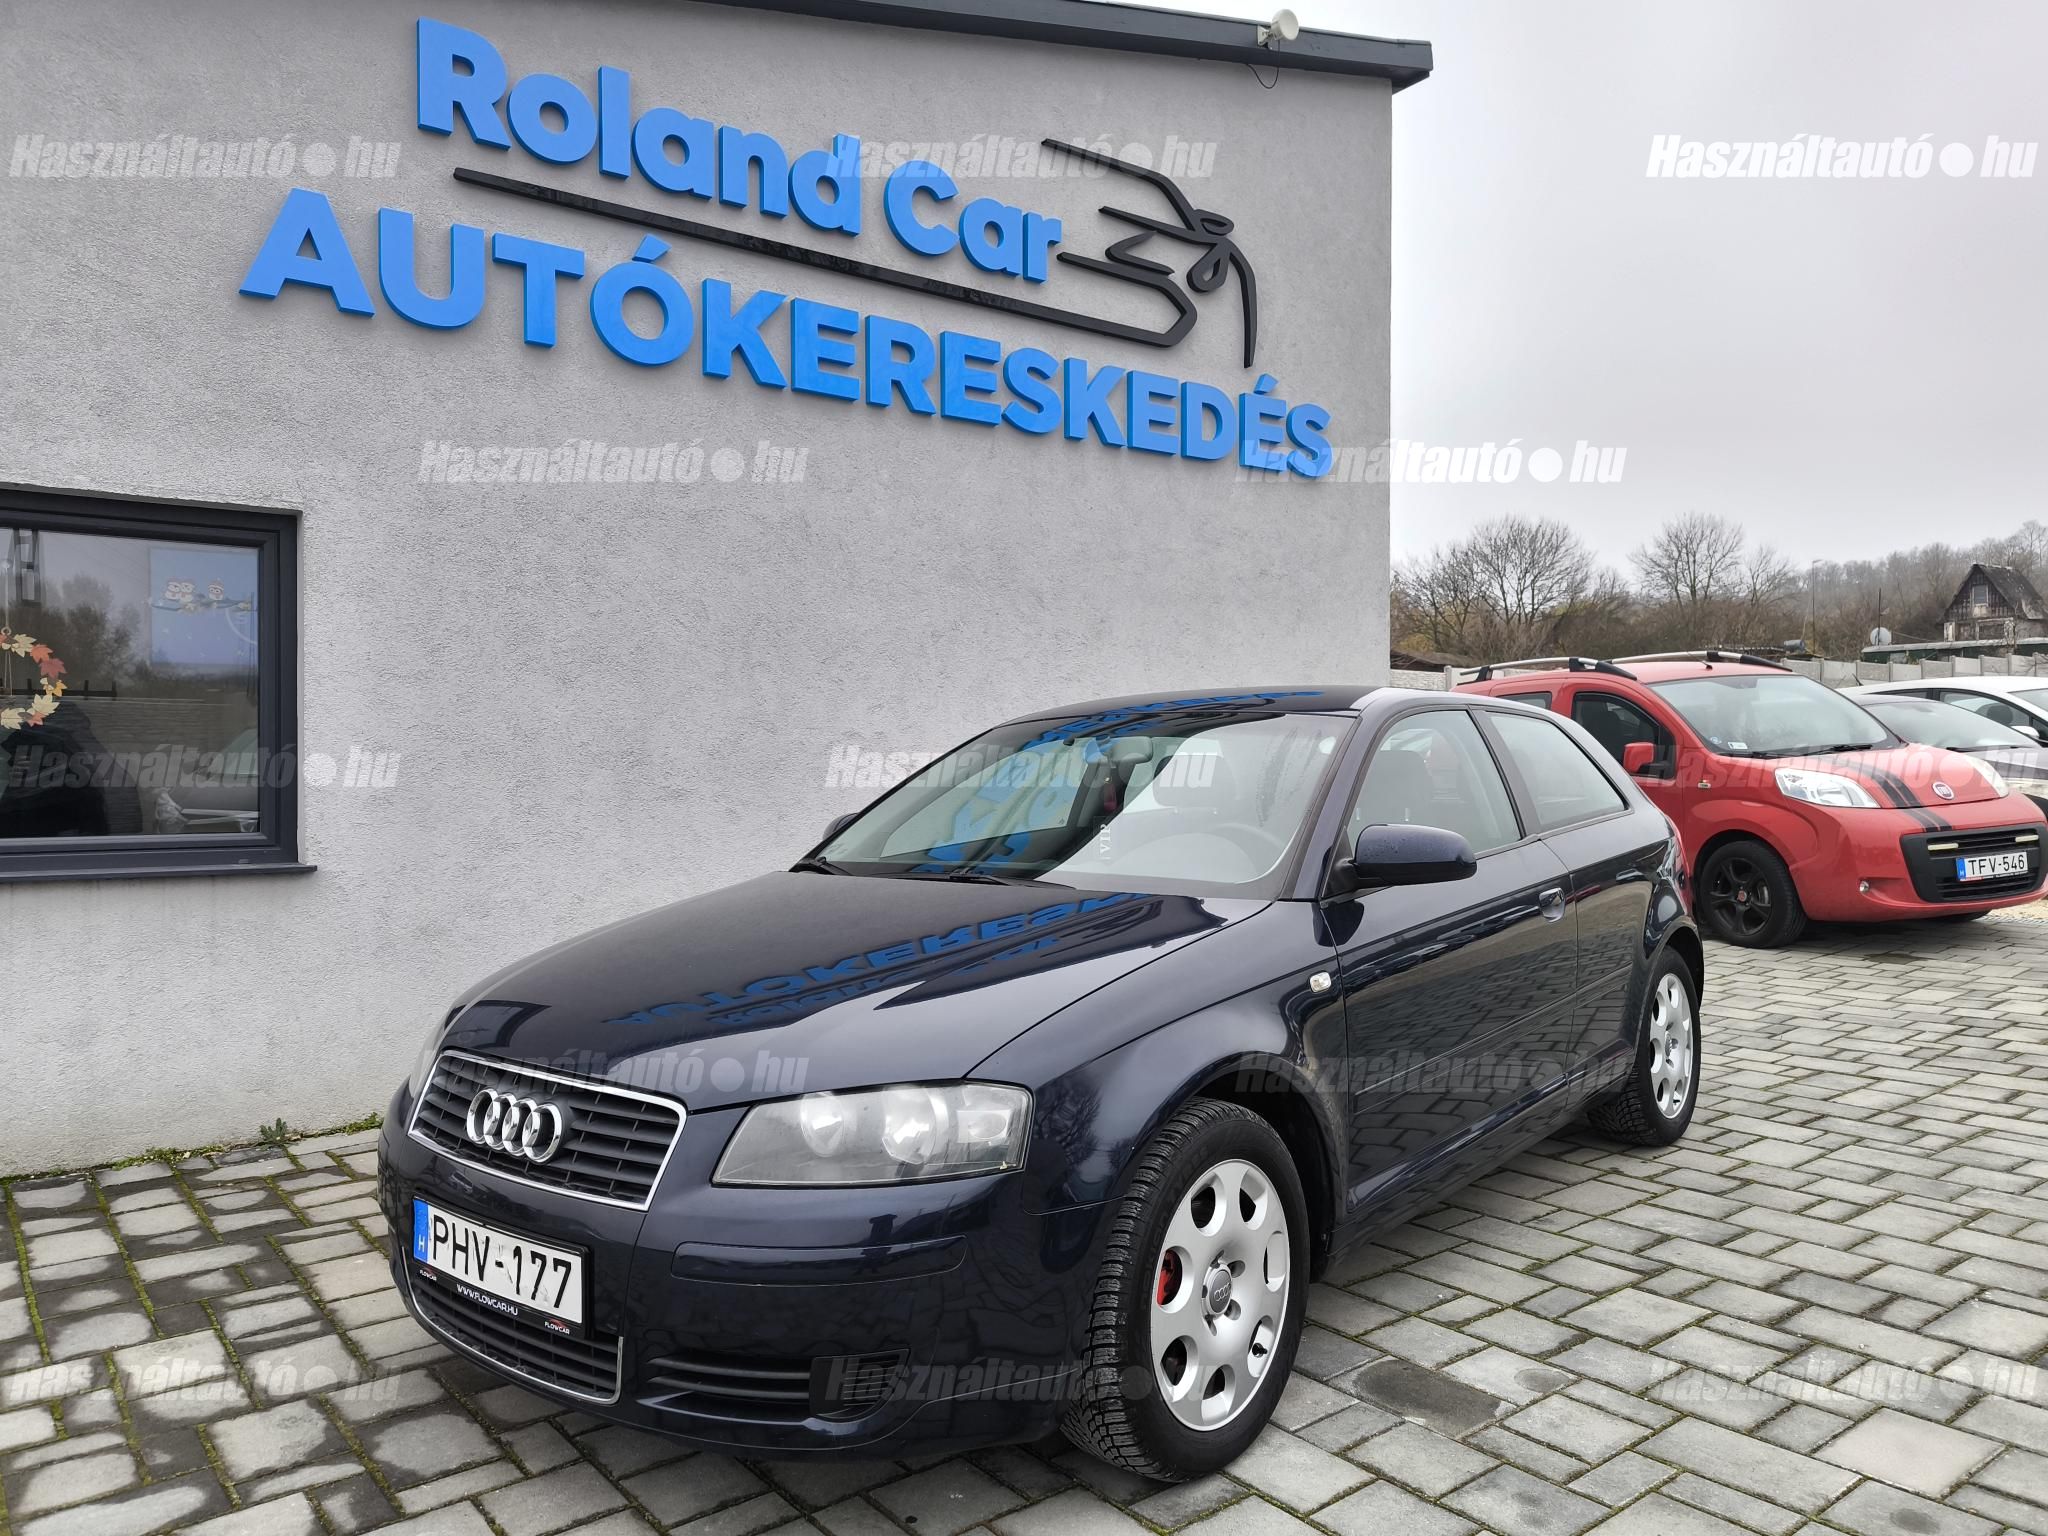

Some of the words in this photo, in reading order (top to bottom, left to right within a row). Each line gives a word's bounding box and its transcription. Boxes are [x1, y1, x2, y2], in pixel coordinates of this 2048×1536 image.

[416, 18, 861, 238] Roland
[883, 160, 1062, 285] Car
[239, 188, 1334, 481] AUTÓKERESKEDÉS
[1968, 854, 2025, 875] TFV-546
[418, 1234, 425, 1252] H
[433, 1214, 572, 1309] PHV-177
[544, 1320, 570, 1335] FLOWCAR
